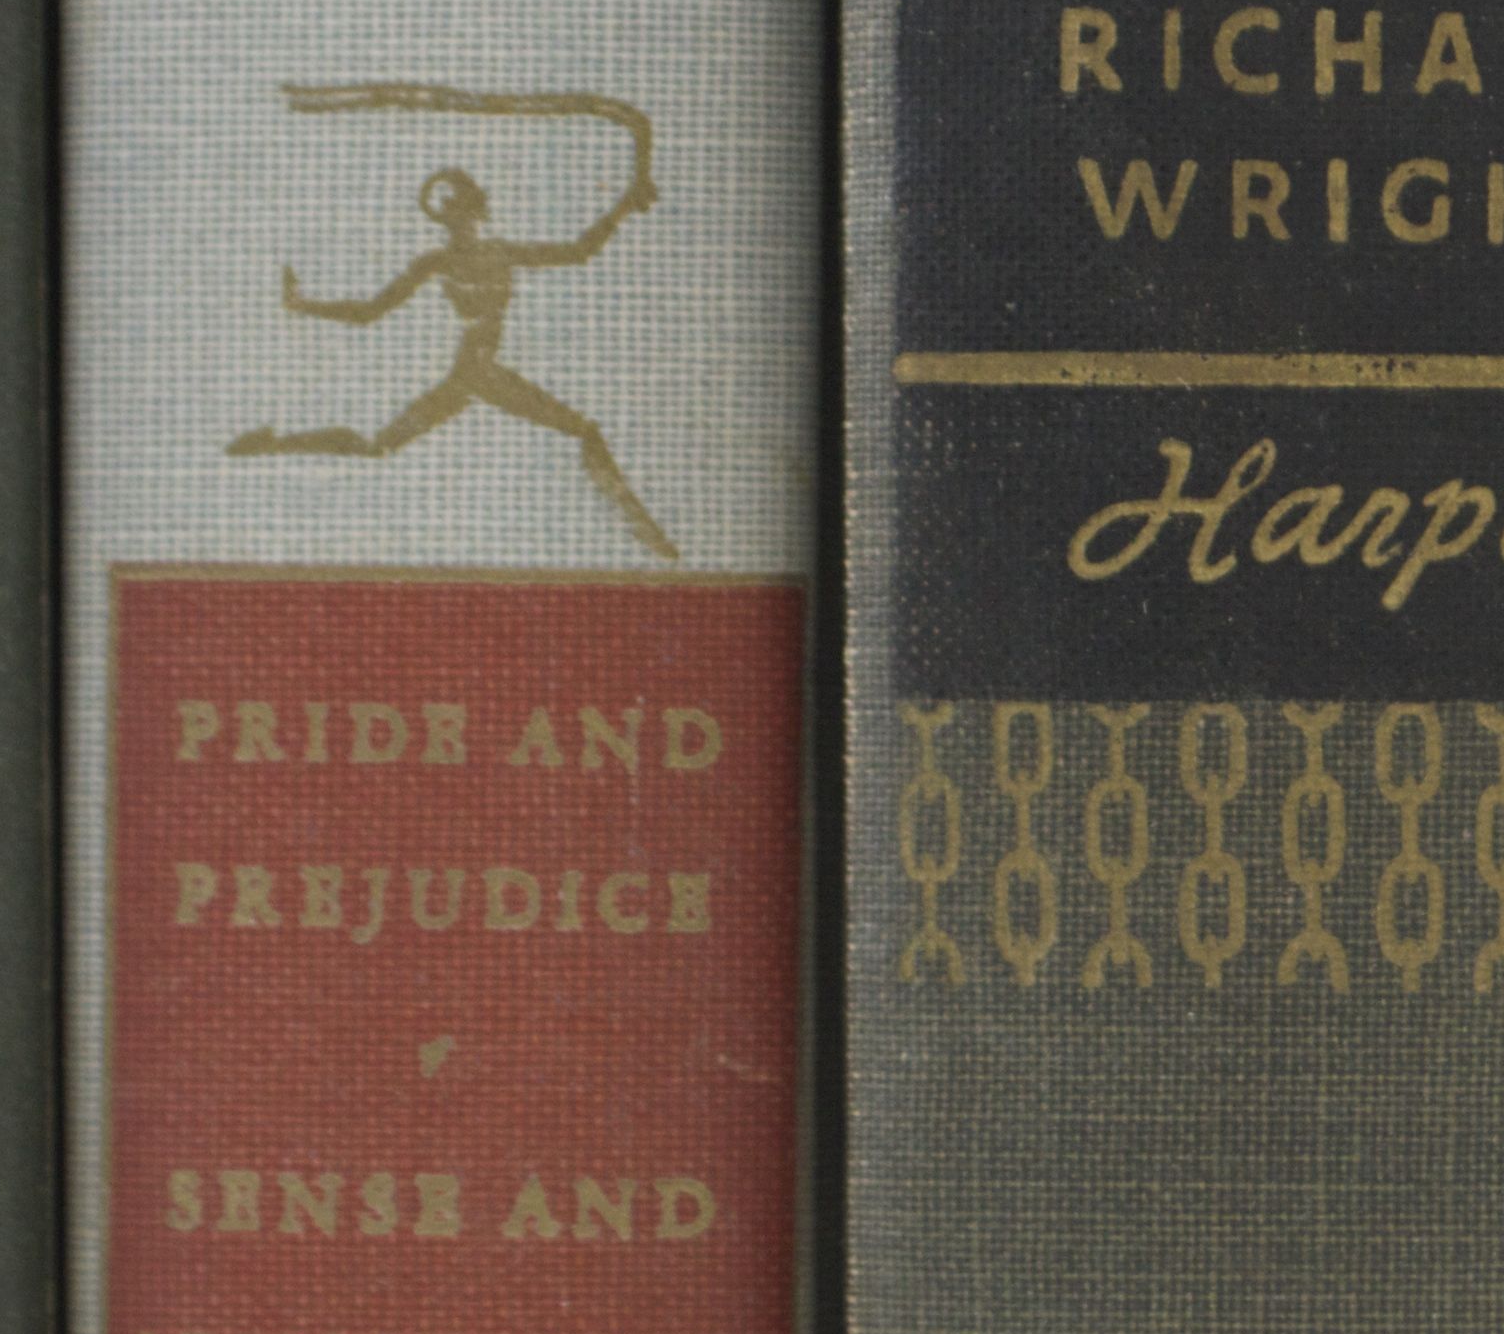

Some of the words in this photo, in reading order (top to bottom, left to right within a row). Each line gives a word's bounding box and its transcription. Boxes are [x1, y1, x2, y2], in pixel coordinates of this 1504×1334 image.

[176, 700, 467, 764] PRIDE
[506, 706, 723, 771] AND
[173, 863, 712, 945] PREJUDICE
[166, 1169, 462, 1239] SENSE
[500, 1174, 717, 1240] AND
